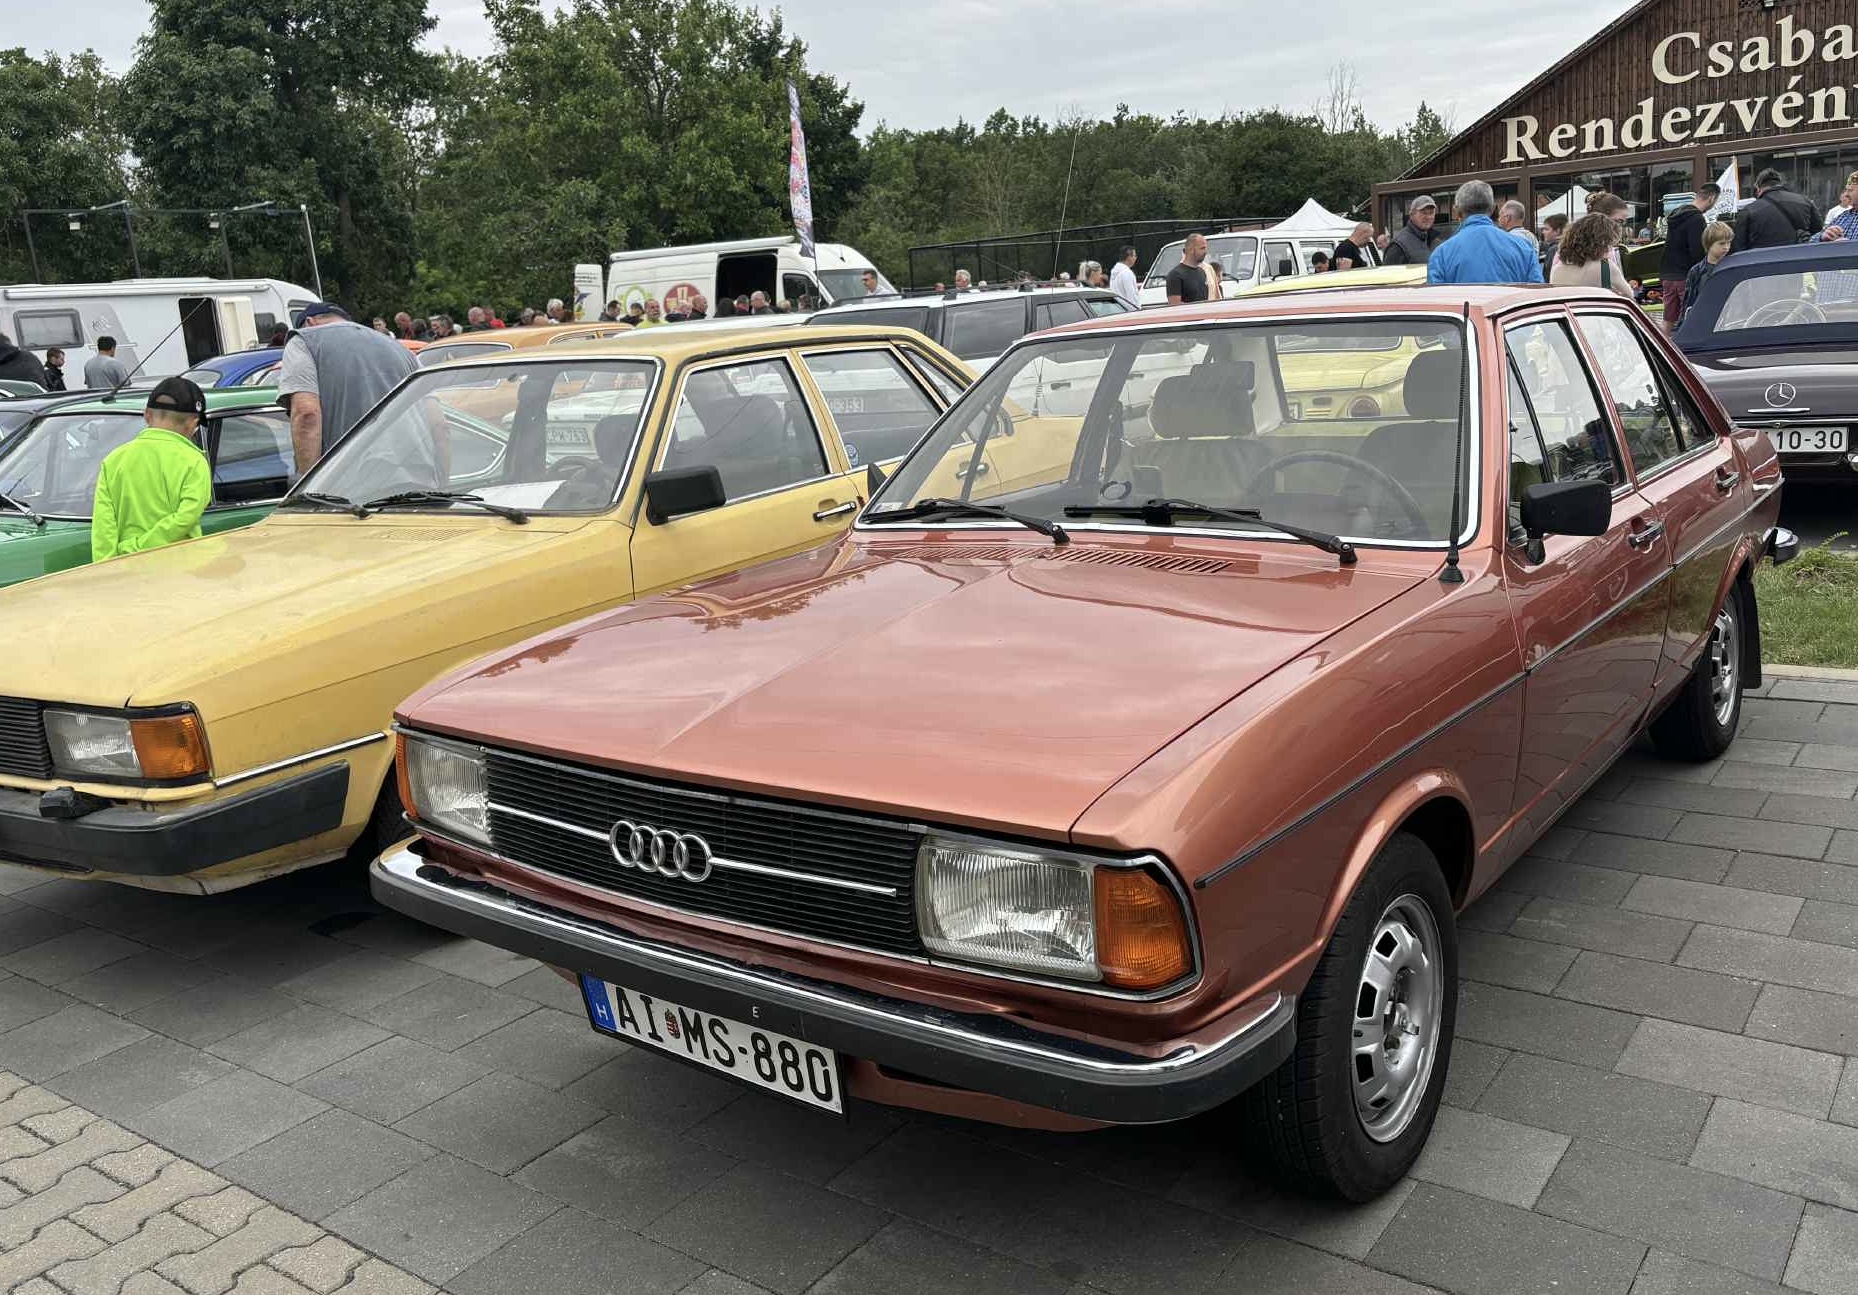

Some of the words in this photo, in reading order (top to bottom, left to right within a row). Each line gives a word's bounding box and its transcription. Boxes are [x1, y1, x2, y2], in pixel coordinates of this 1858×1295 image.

[1500, 75, 1858, 163] Rendezvén
[596, 1003, 608, 1020] H
[616, 987, 663, 1042] AI
[678, 1006, 833, 1102] MS-880
